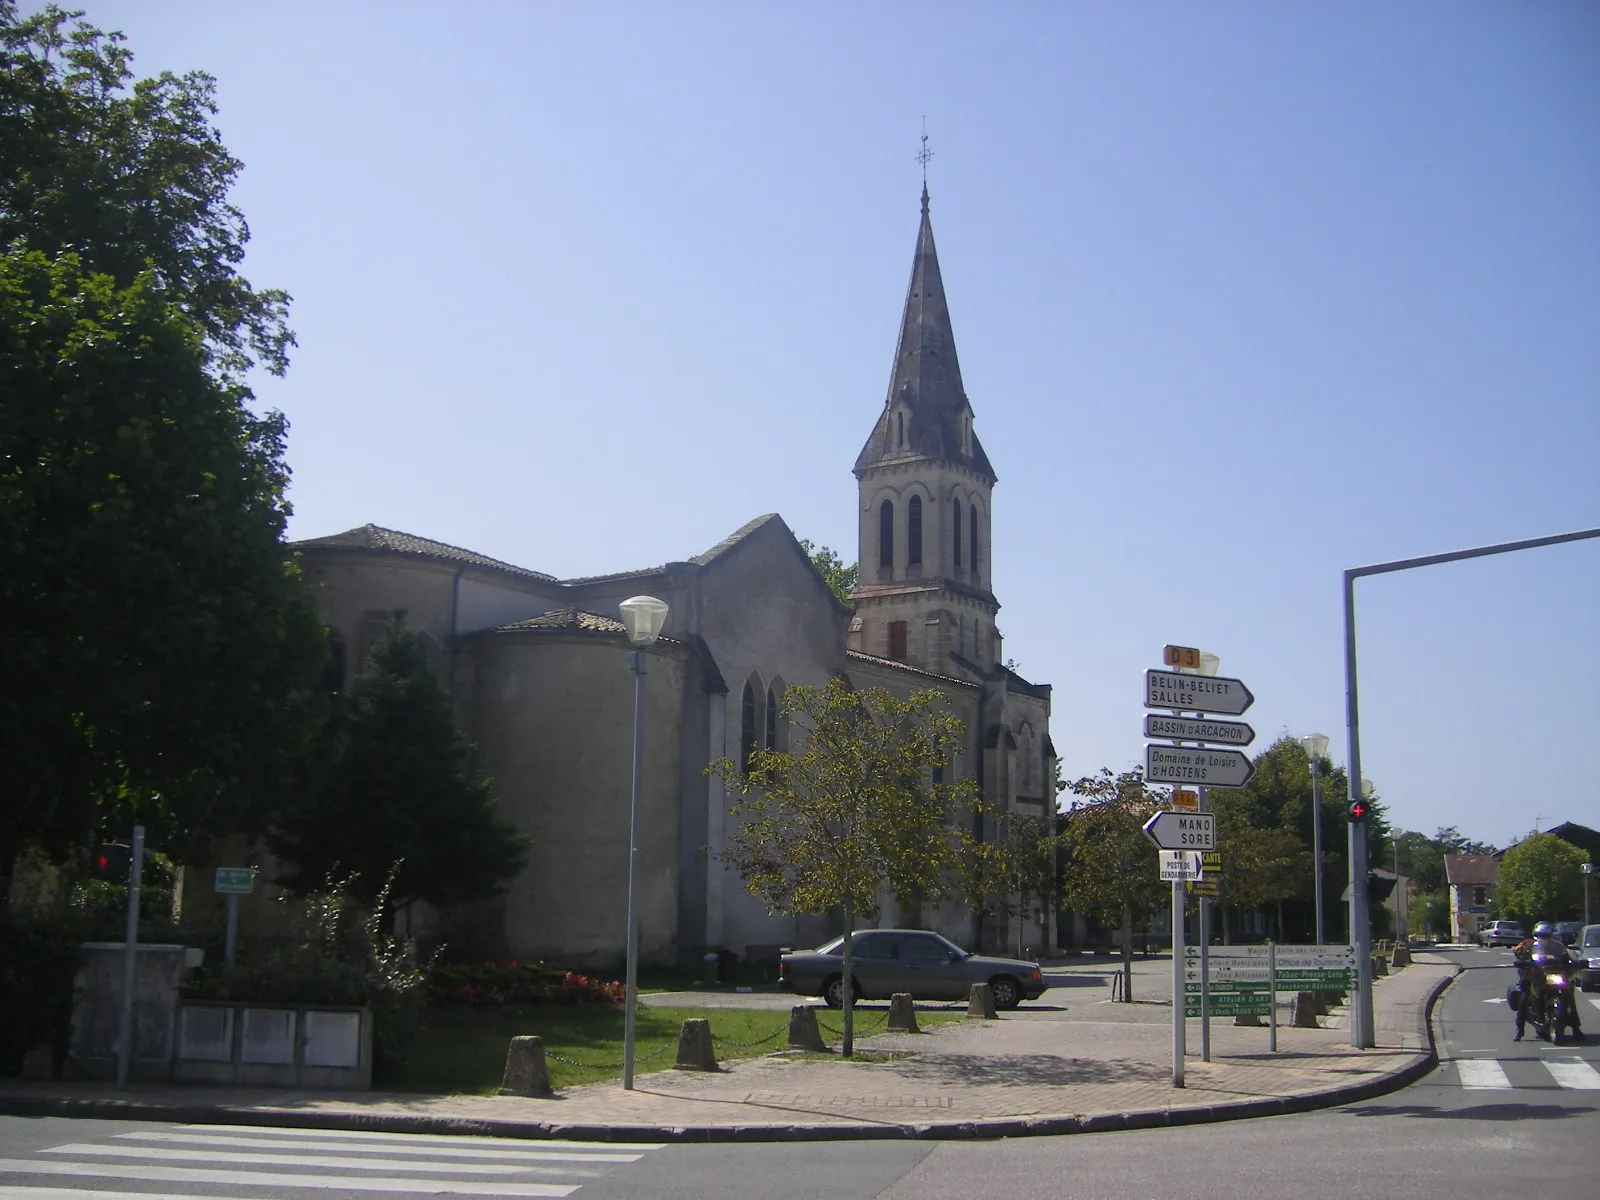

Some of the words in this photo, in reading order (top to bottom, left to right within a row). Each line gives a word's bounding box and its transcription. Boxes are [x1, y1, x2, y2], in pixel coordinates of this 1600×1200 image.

[1151, 676, 1229, 695] BELIN-BELIET
[1151, 690, 1194, 705] SALLES
[1152, 720, 1186, 735] BASSIN
[1152, 751, 1191, 765] Domaine
[1194, 754, 1206, 765] de
[1209, 755, 1237, 768] Loisirs
[1179, 819, 1210, 831] MANO
[1181, 833, 1210, 845] SORE
[1166, 861, 1183, 870] POSTE
[1184, 861, 1190, 870] DE
[1161, 871, 1197, 879] GENDARMERIE
[1277, 958, 1301, 967] Office
[1301, 958, 1312, 966] de
[1312, 958, 1343, 966] Tourisme
[1218, 995, 1246, 1003] ATELIER
